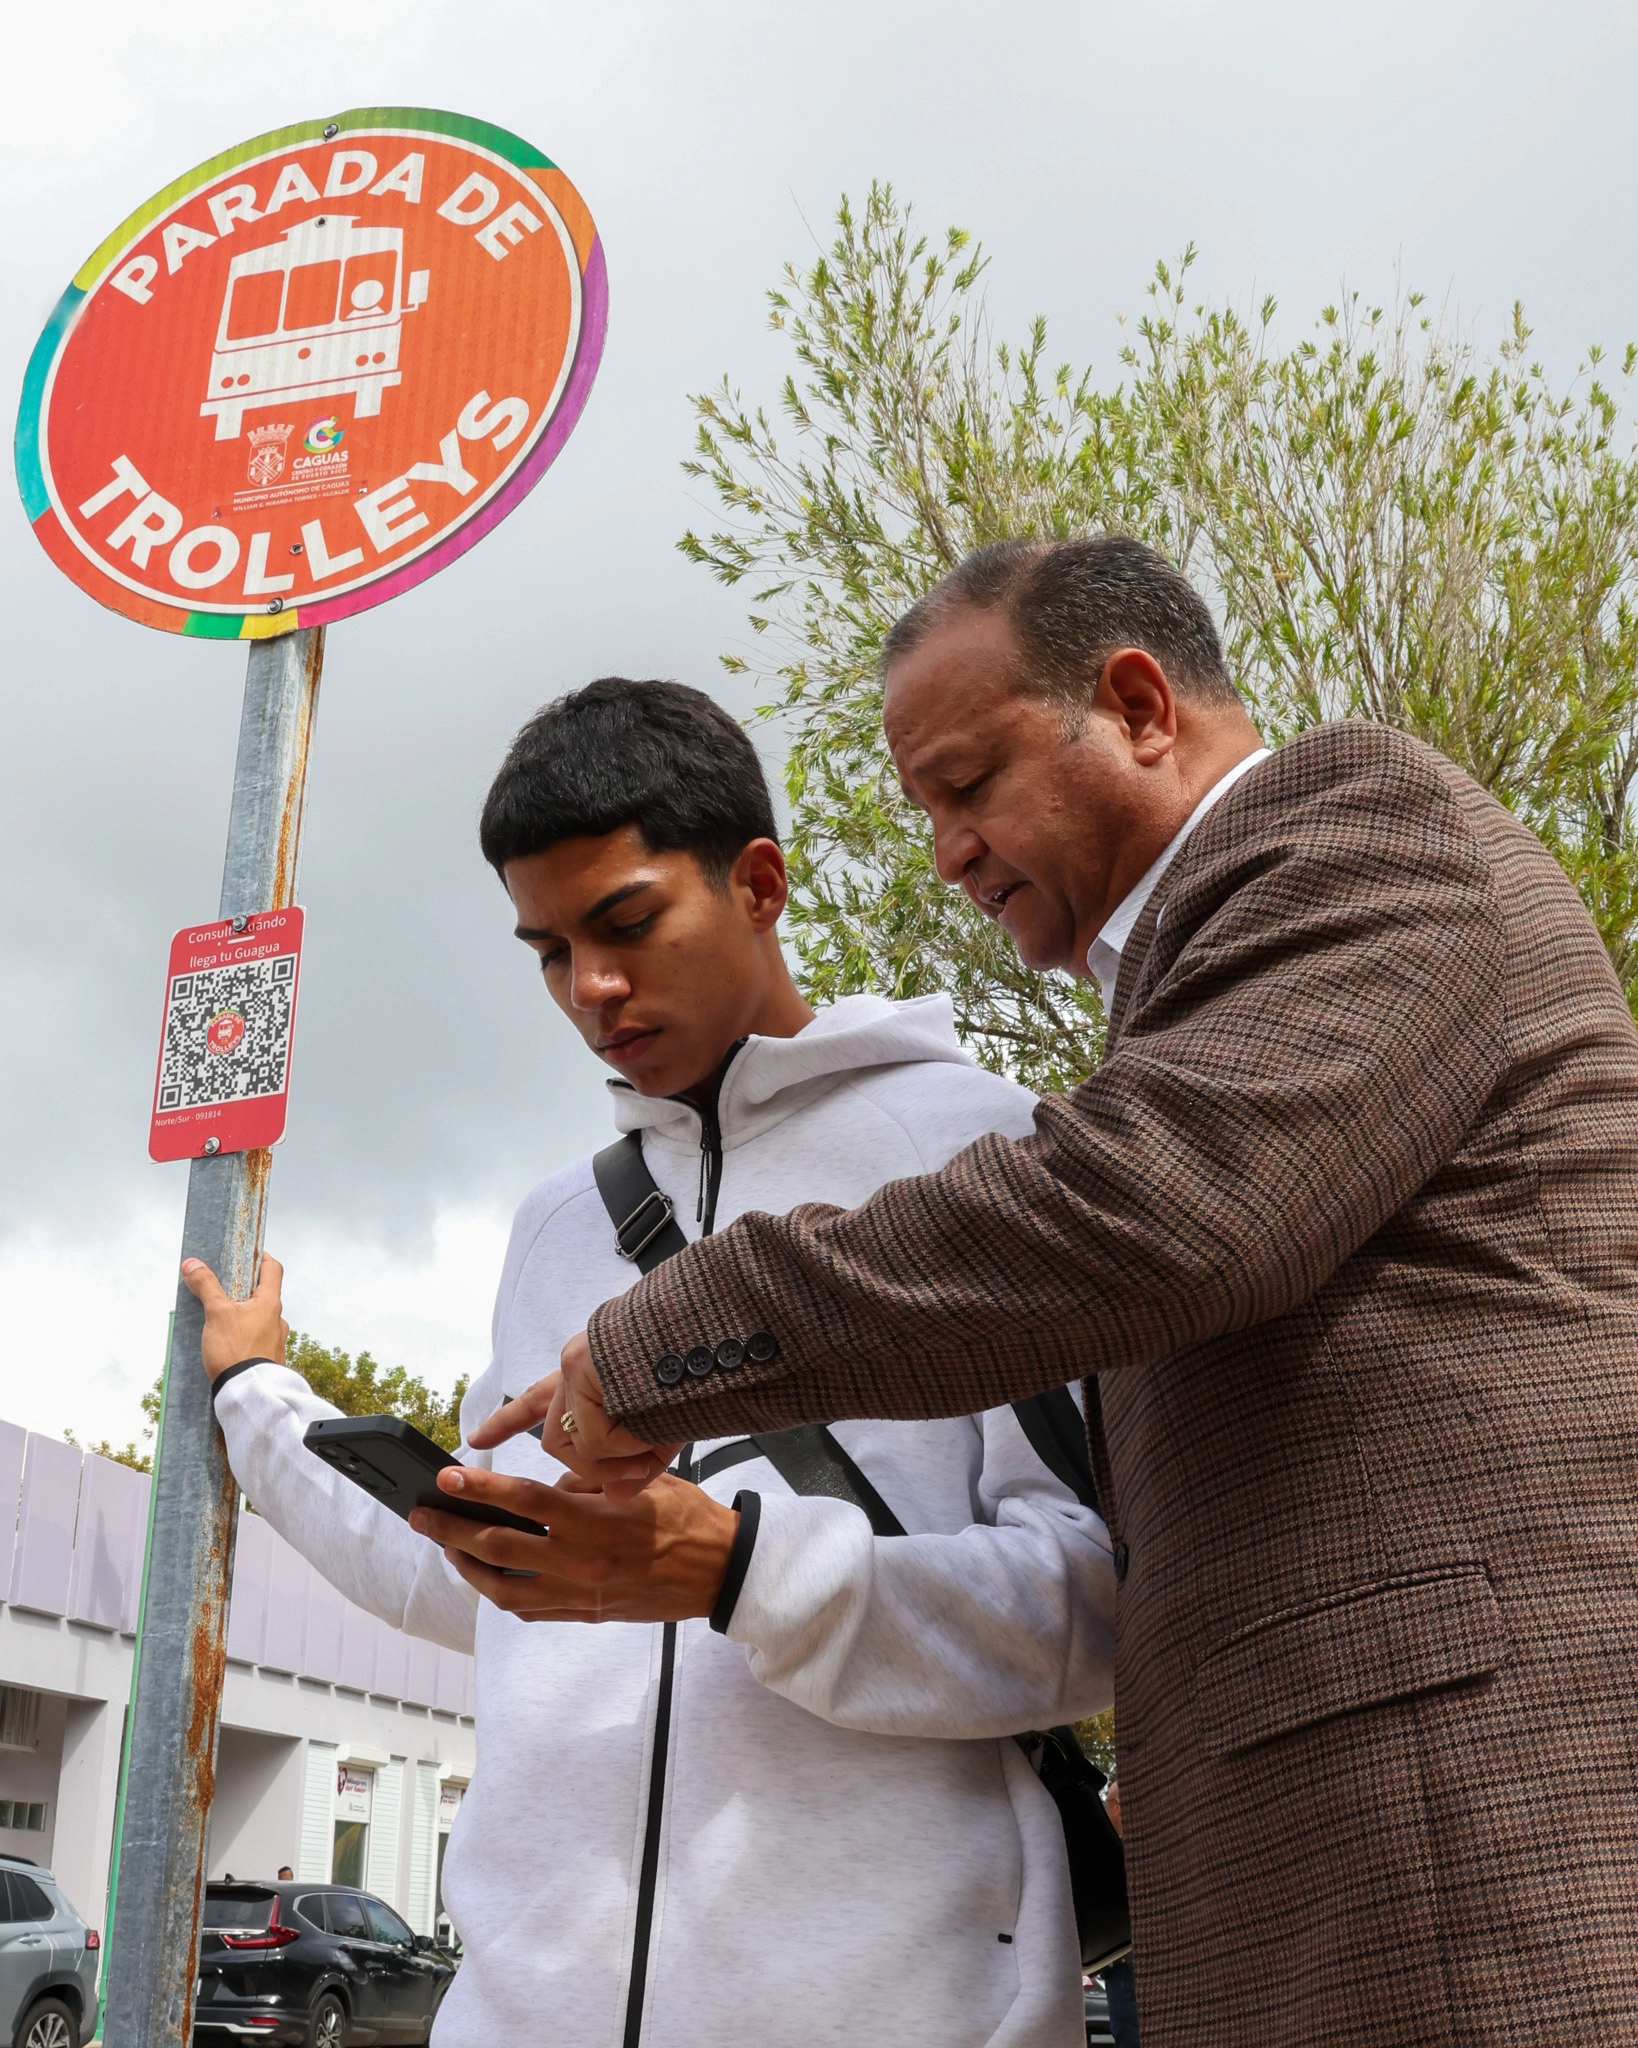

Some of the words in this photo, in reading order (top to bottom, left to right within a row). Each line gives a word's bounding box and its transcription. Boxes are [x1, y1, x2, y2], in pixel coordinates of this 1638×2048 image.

[109, 151, 425, 306] PARADA
[436, 171, 544, 262] DE
[291, 468, 314, 476] CENTRO
[319, 462, 348, 472] CORAZÓN
[293, 450, 349, 469] CAGUAS
[301, 471, 328, 479] PUERTO
[78, 389, 530, 595] TROLLEYS
[232, 502, 258, 511] WILLIAM
[265, 498, 293, 506] MIRANDA
[294, 494, 317, 502] TORRES
[322, 488, 350, 497] ALCALDE
[233, 493, 268, 504] MUNICIPIO
[270, 486, 309, 498] AUTÓNOMO
[321, 480, 350, 490] CAGUAS
[190, 955, 217, 968] llega
[220, 951, 232, 962] tu
[235, 942, 280, 958] Guagua
[211, 1013, 235, 1027] PARADA
[209, 1035, 241, 1052] TROLLEYS
[155, 1115, 190, 1127] Norte/Sur
[195, 1109, 222, 1121] 091814
